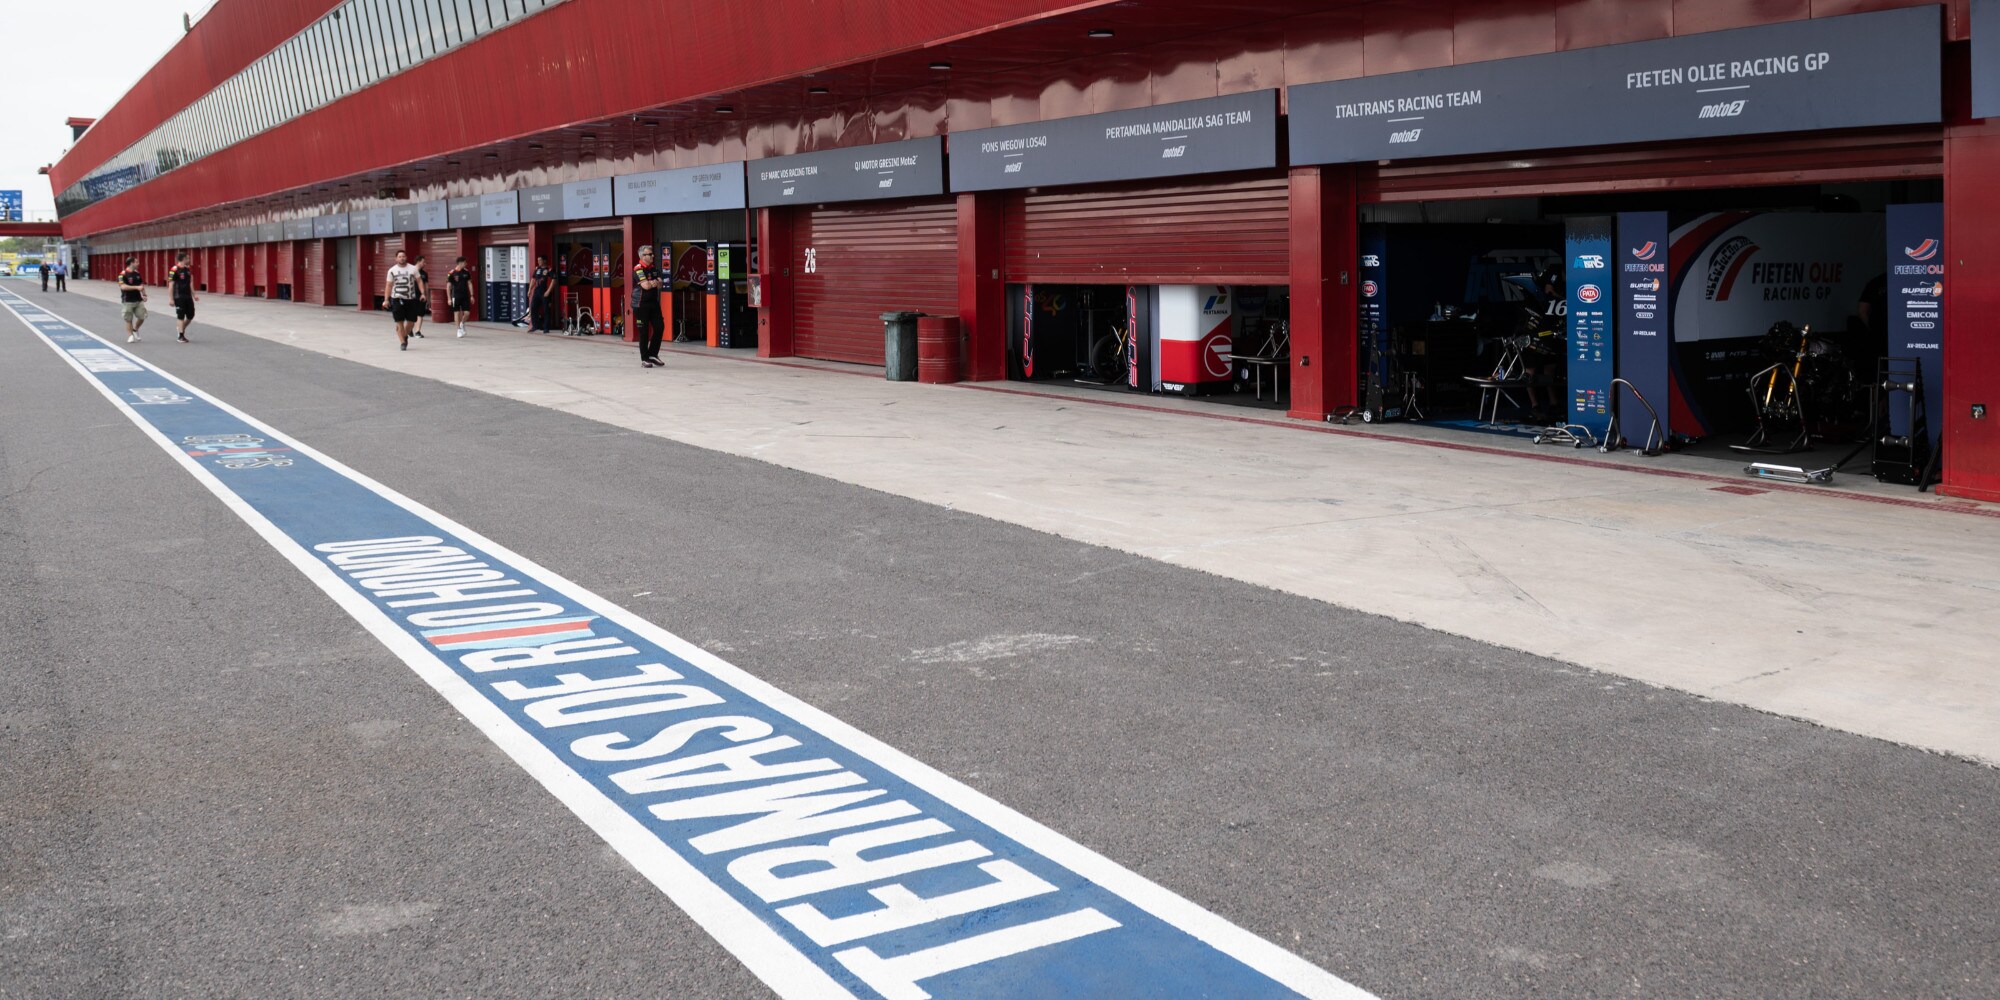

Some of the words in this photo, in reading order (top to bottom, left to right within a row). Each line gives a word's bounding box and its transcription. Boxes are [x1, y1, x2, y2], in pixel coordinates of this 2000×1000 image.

[1626, 67, 1683, 89] FIETEN
[1687, 63, 1725, 83] OLIE
[1731, 56, 1799, 79] RACING
[1804, 52, 1830, 71] GP
[1335, 99, 1395, 119] ITALTRANS
[1397, 94, 1443, 112] RACING
[1446, 90, 1482, 107] TEAM
[1105, 123, 1151, 139] PERTAMINA
[1152, 117, 1204, 134] MANDALIKA
[1206, 114, 1223, 128] SAG
[1226, 110, 1251, 125] TEAM
[981, 142, 999, 153] PONS
[1000, 138, 1025, 151] WEGOW
[1026, 135, 1047, 148] LOS40
[804, 166, 818, 175] TEAM
[861, 159, 879, 170] MOTOR
[879, 157, 900, 169] GRESINI
[804, 247, 816, 274] 26
[1624, 263, 1648, 272] FIETEN
[1648, 263, 1665, 272] OLIE
[1894, 264, 1927, 275] FIETEN
[1927, 264, 1944, 275] OLI
[1752, 262, 1805, 284] FIETEN
[1808, 262, 1844, 284] OLIE
[1763, 286, 1811, 301] RACING
[1815, 286, 1832, 300] GP
[1545, 300, 1567, 316] 16
[314, 535, 538, 609] HONDO
[490, 661, 727, 729] DE
[570, 715, 1123, 1000] TERMAS
